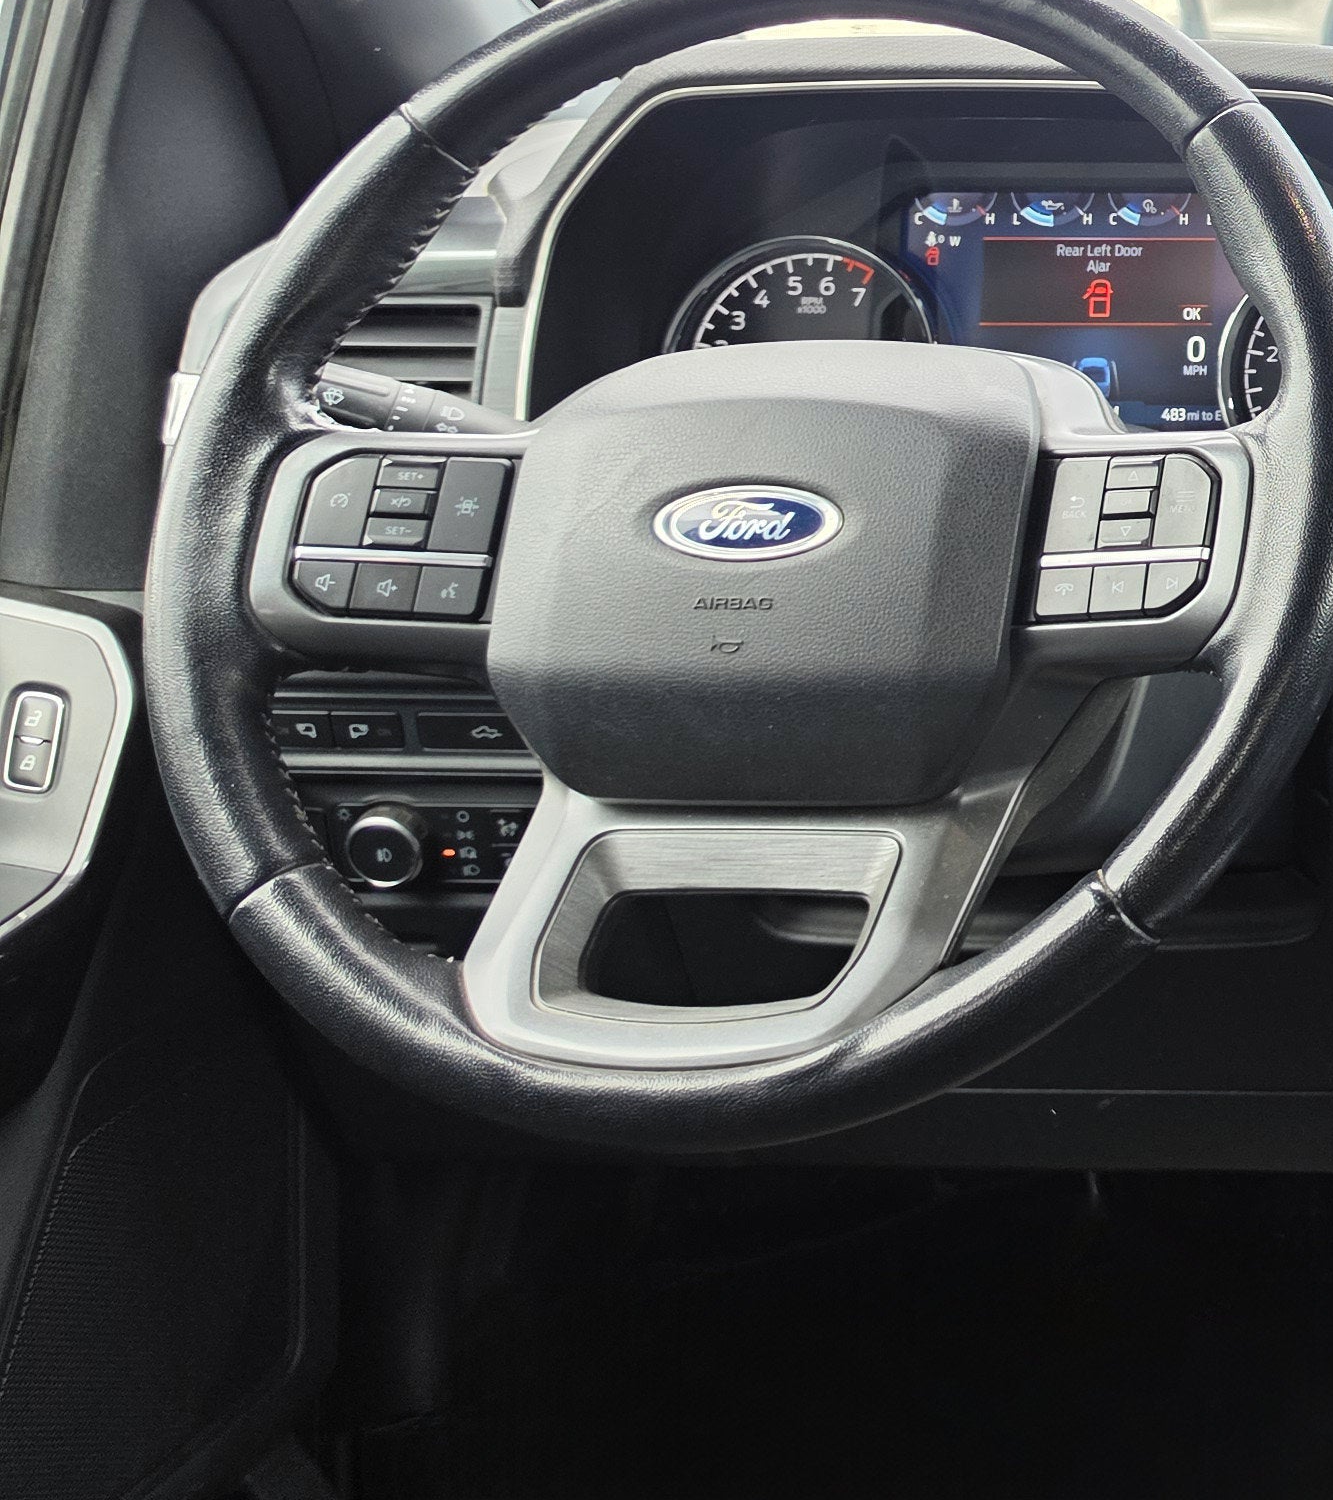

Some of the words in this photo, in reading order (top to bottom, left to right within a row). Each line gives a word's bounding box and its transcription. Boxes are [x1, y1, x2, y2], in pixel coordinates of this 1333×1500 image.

[914, 213, 924, 225] C
[985, 213, 995, 225] H
[1013, 213, 1021, 225] L
[1083, 213, 1093, 225] H
[1109, 213, 1118, 225] C
[1180, 213, 1189, 225] H
[1056, 244, 1084, 257] Rear
[1087, 244, 1112, 257] Left
[1115, 244, 1143, 257] Door
[1087, 260, 1111, 274] Ajar
[787, 276, 803, 295] 5
[819, 276, 836, 295] 6
[753, 289, 770, 308] 4
[801, 297, 824, 306] RPM
[851, 288, 867, 307] 7
[730, 310, 746, 331] 3
[1183, 308, 1202, 321] OK
[1186, 336, 1206, 362] 0
[1183, 365, 1208, 376] MPH
[1161, 408, 1186, 422] 483
[1187, 409, 1200, 422] mi
[1202, 410, 1214, 422] to
[699, 500, 796, 541] Ford
[1062, 510, 1086, 519] BACK
[693, 596, 774, 610] AIRBAG
